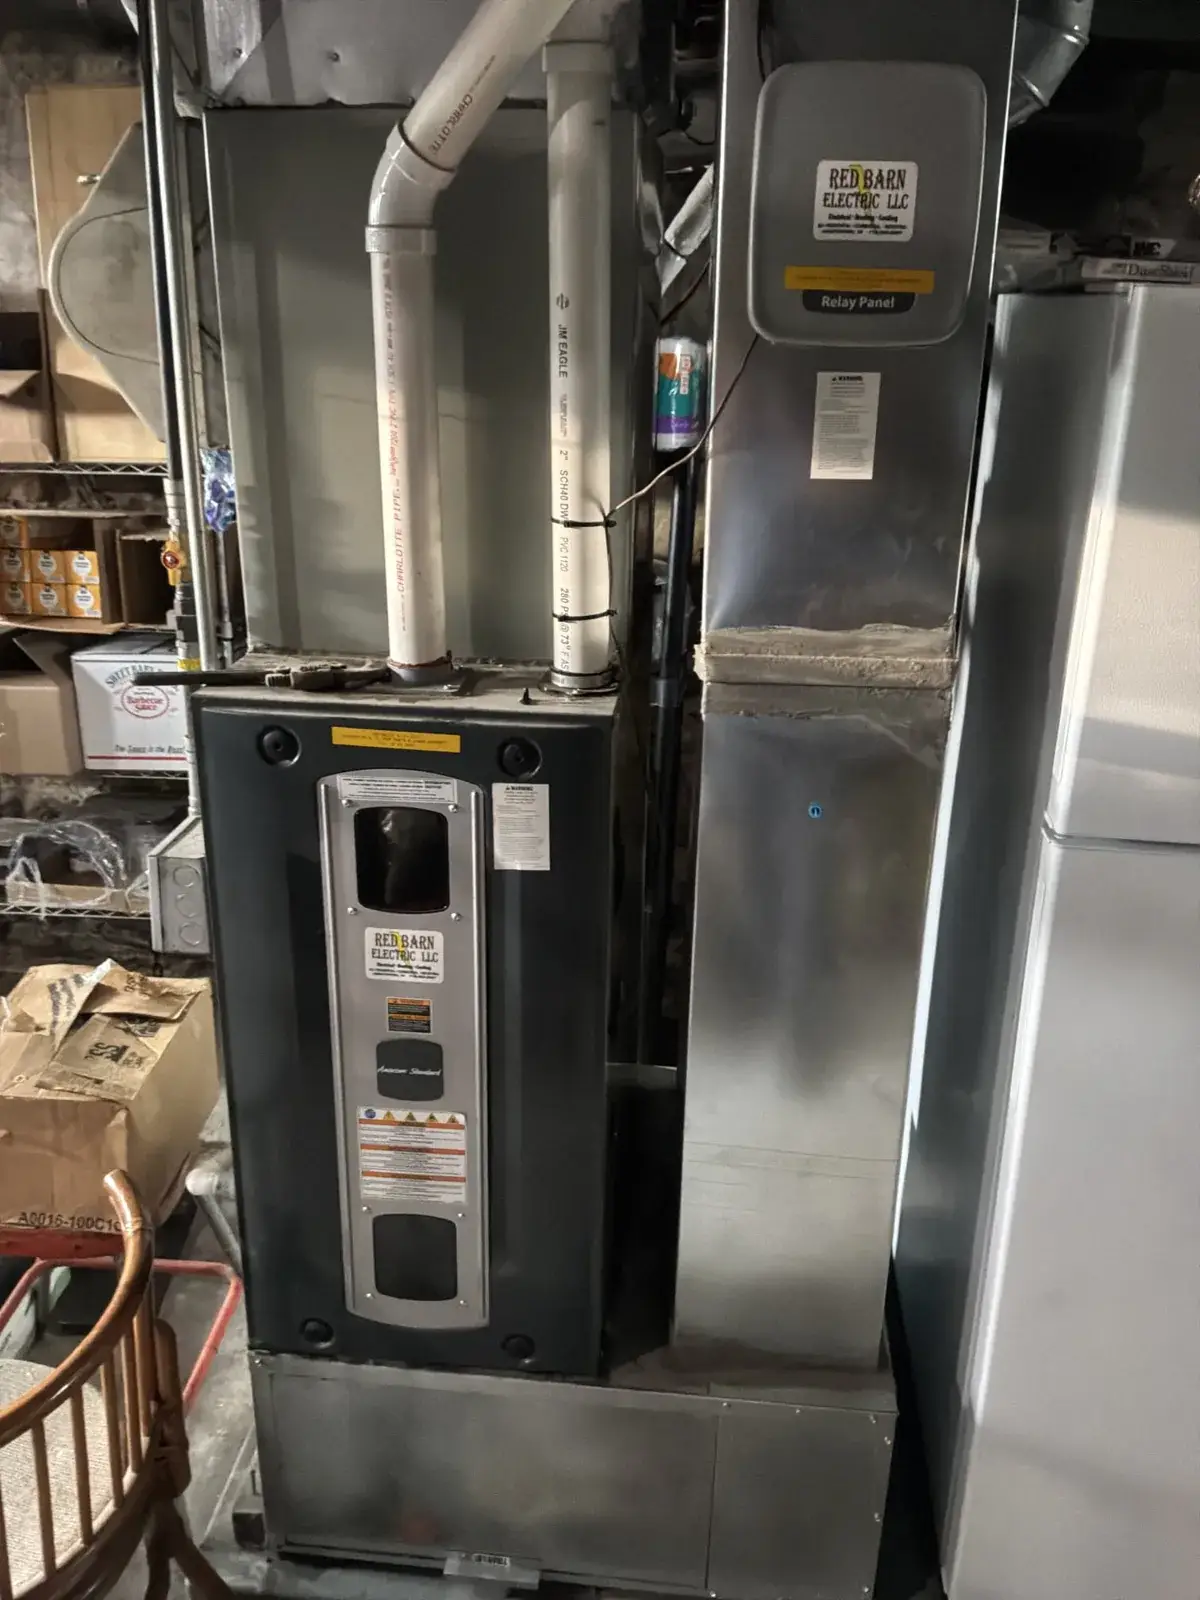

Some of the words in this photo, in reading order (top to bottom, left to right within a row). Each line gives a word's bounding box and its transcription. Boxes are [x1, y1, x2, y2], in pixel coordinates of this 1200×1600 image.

[829, 168, 859, 190] RED
[863, 168, 907, 190] BARN
[823, 191, 880, 209] ELECTRIC
[886, 193, 909, 209] LLC
[821, 295, 856, 311] Relay
[859, 295, 895, 309] Panel
[558, 323, 568, 339] JM
[558, 342, 568, 378] EAGLE
[559, 503, 570, 520] DW
[559, 537, 569, 553] PVC
[394, 528, 405, 592] CHARLOTTE
[559, 587, 569, 603] 280
[375, 933, 398, 947] RED
[401, 935, 435, 950] BARN
[371, 948, 416, 962] ELECTRIC
[421, 952, 439, 963] LLC
